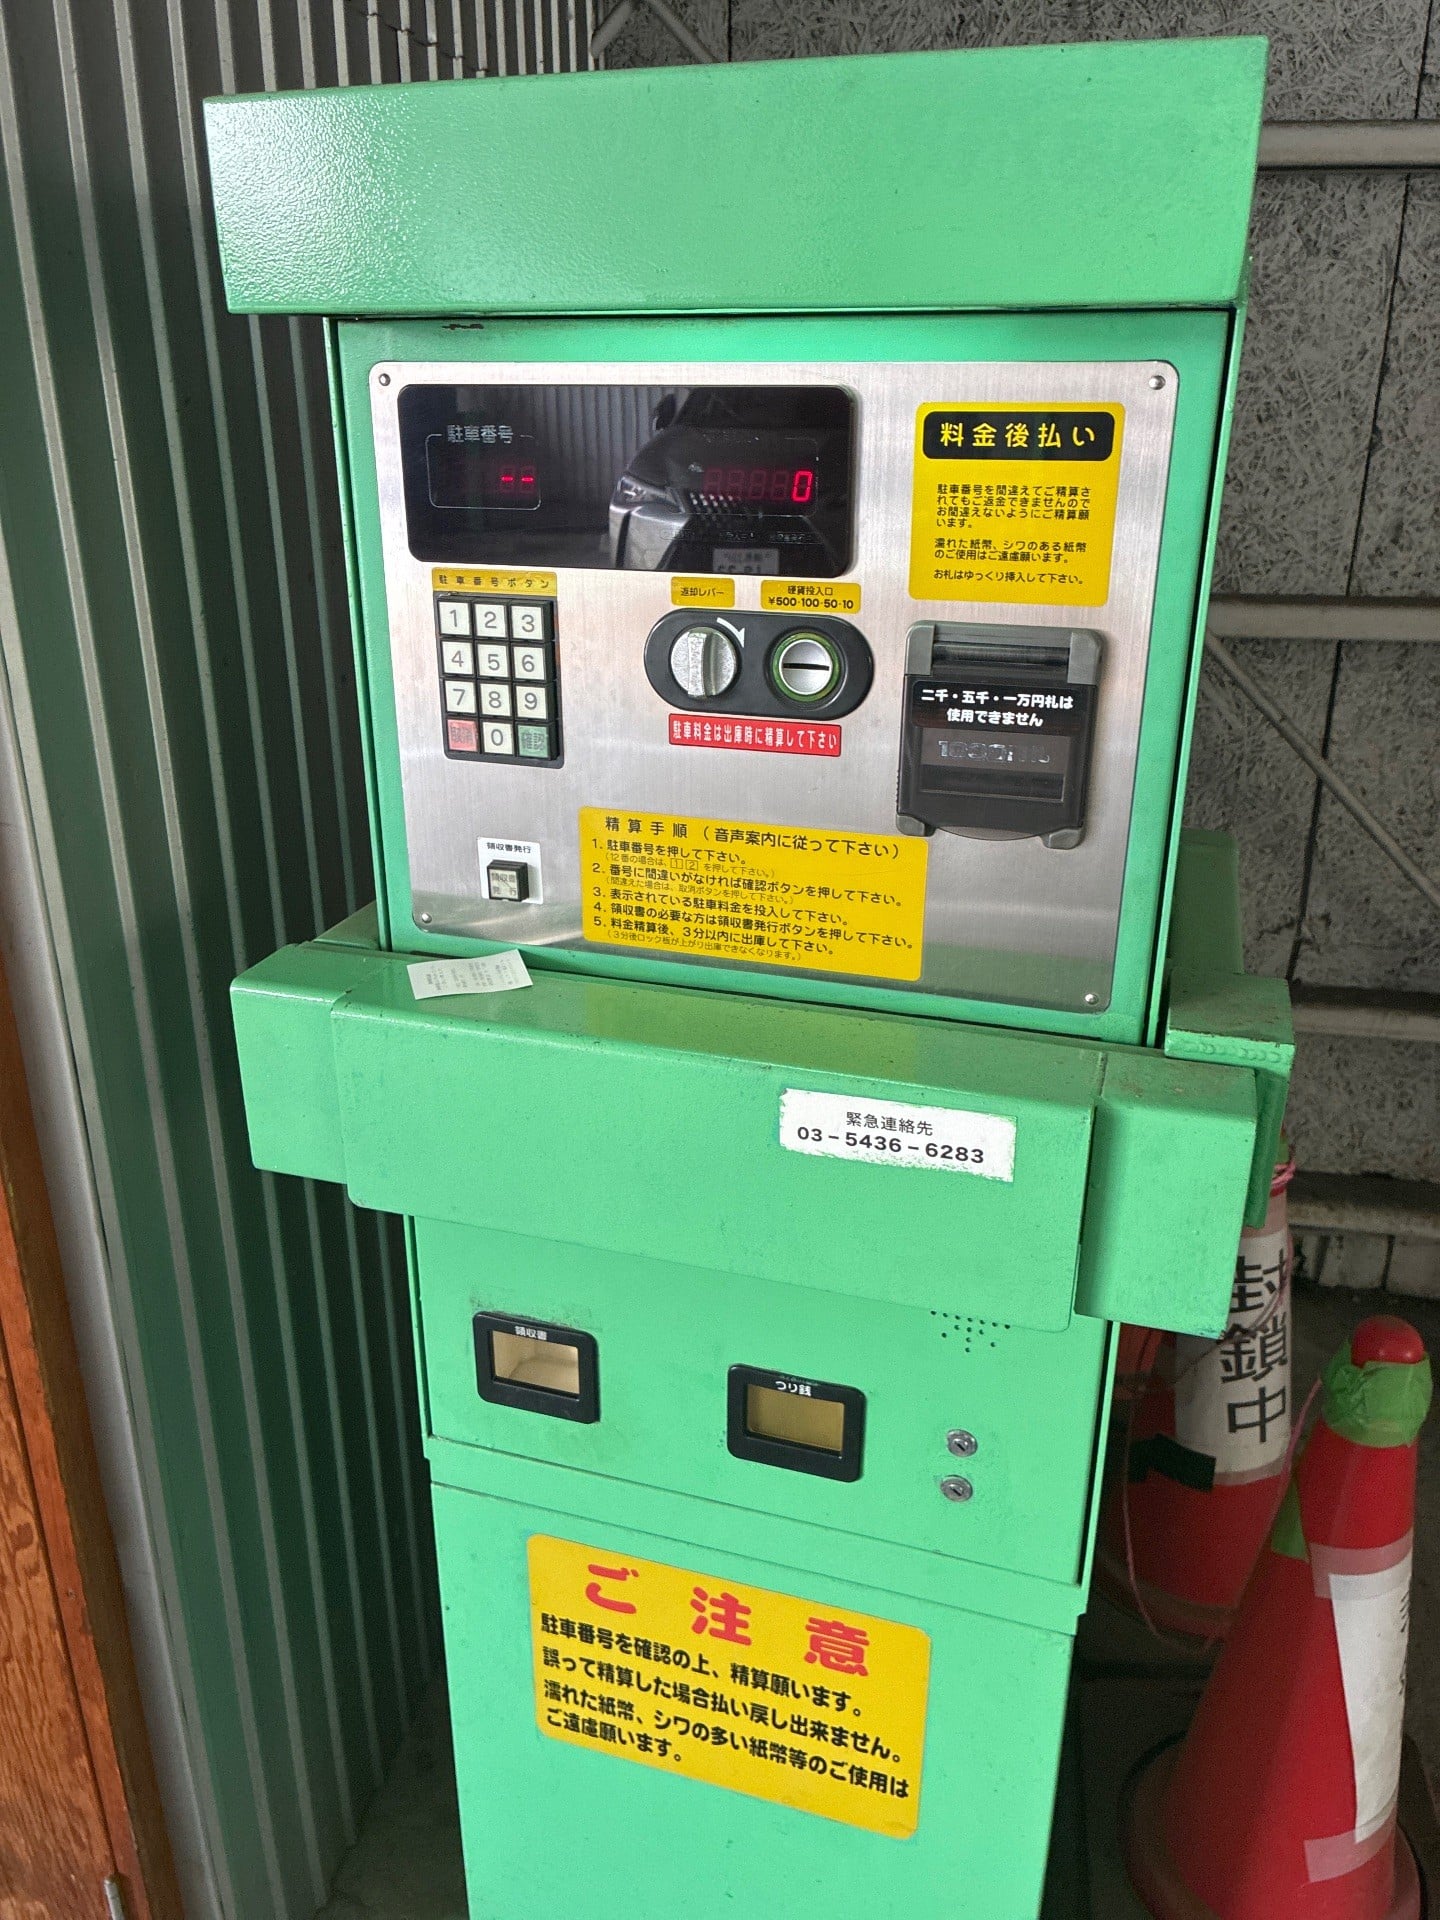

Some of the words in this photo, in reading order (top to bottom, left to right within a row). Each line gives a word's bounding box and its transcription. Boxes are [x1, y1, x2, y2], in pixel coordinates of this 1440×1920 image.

[447, 425, 513, 443] 駐車番号
[940, 422, 1096, 448] 料金後払い
[792, 470, 813, 502] 0
[937, 484, 1092, 497] 駐車番号を間違えてご精算さ
[937, 495, 1091, 509] れてもご返金できませんので
[936, 506, 1090, 521] お間違えないようにご精算願
[936, 518, 973, 529] います。
[934, 537, 1087, 553] 濡れた紙幣、シワのある紙幣
[934, 549, 1068, 564] のご使用はご遠慮願います。
[439, 575, 550, 589] 駐車番号ボタン
[933, 568, 1083, 584] お札はゆっくり挿入して下さい。
[680, 584, 724, 597] 返却レバー
[788, 585, 833, 597] 硬貨投入口
[449, 609, 458, 628] 1
[484, 611, 498, 629] 2
[521, 614, 535, 633] 3
[451, 650, 464, 668] 4
[487, 653, 500, 671] 5
[521, 654, 535, 673] 6
[452, 688, 466, 706] 7
[488, 691, 502, 709] 8
[524, 692, 538, 710] 9
[921, 688, 1074, 710] 二千・五千・一万円札は
[946, 708, 1044, 728] 使用できません
[491, 728, 504, 746] 0
[672, 720, 837, 750] 駐車料金は出庫時に精算して下さい
[846, 1111, 934, 1137] 緊急連絡先
[585, 1563, 870, 1677] ご注意
[541, 1612, 862, 1717] 駐車番号を確認の上、精算願います。
[542, 1646, 901, 1763] 誤って精算した場合払い戻し出来ません。
[543, 1678, 910, 1799] 濡れた紙幣、シワの多い紙幣等のご使用は
[546, 1706, 682, 1763] ご遠慮願います。
